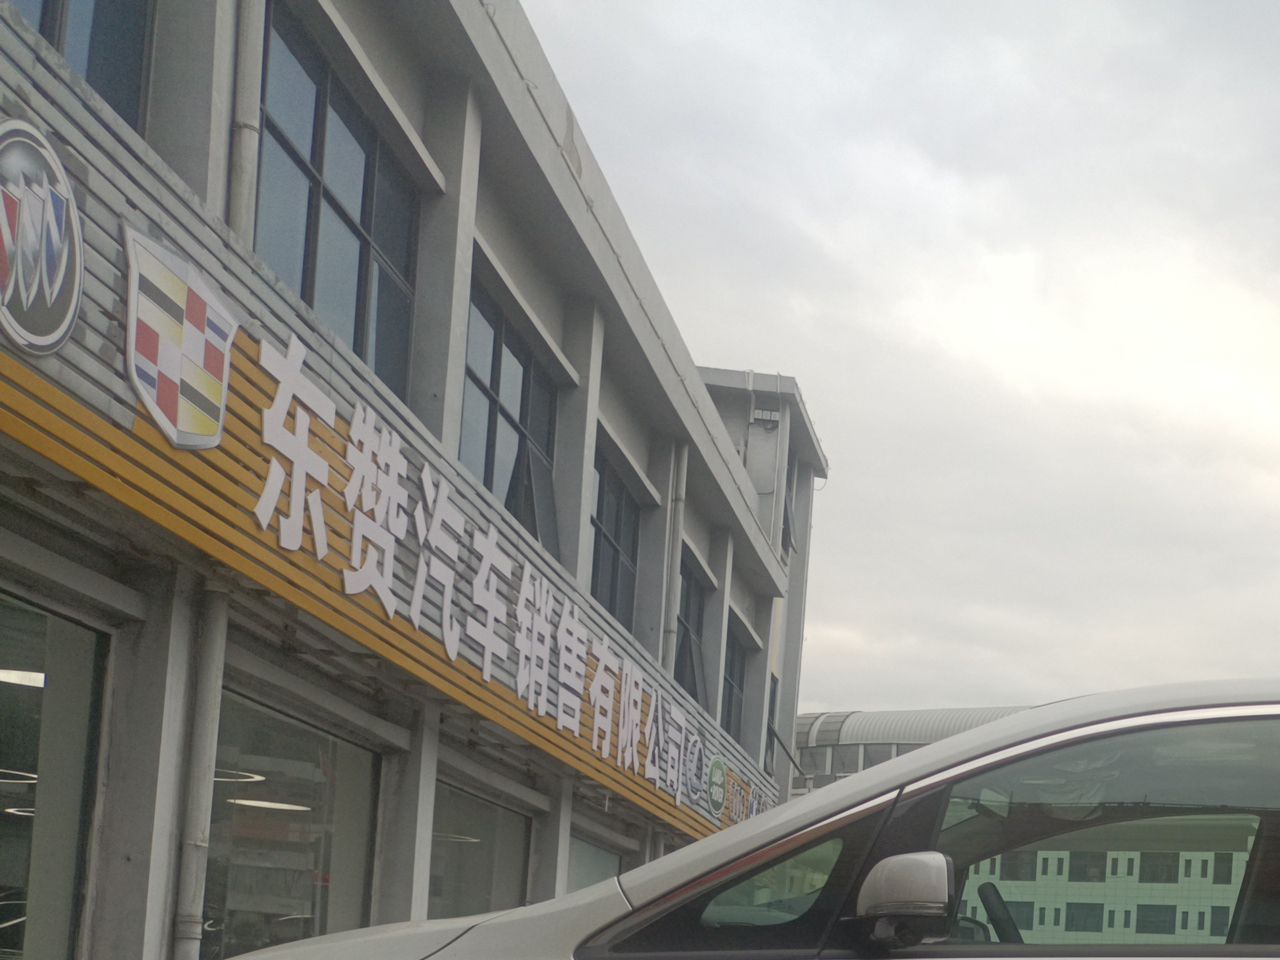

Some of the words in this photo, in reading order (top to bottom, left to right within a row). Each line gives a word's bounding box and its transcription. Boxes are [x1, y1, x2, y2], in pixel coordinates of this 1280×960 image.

[253, 333, 686, 806] 东赞汽车销售有限公司
